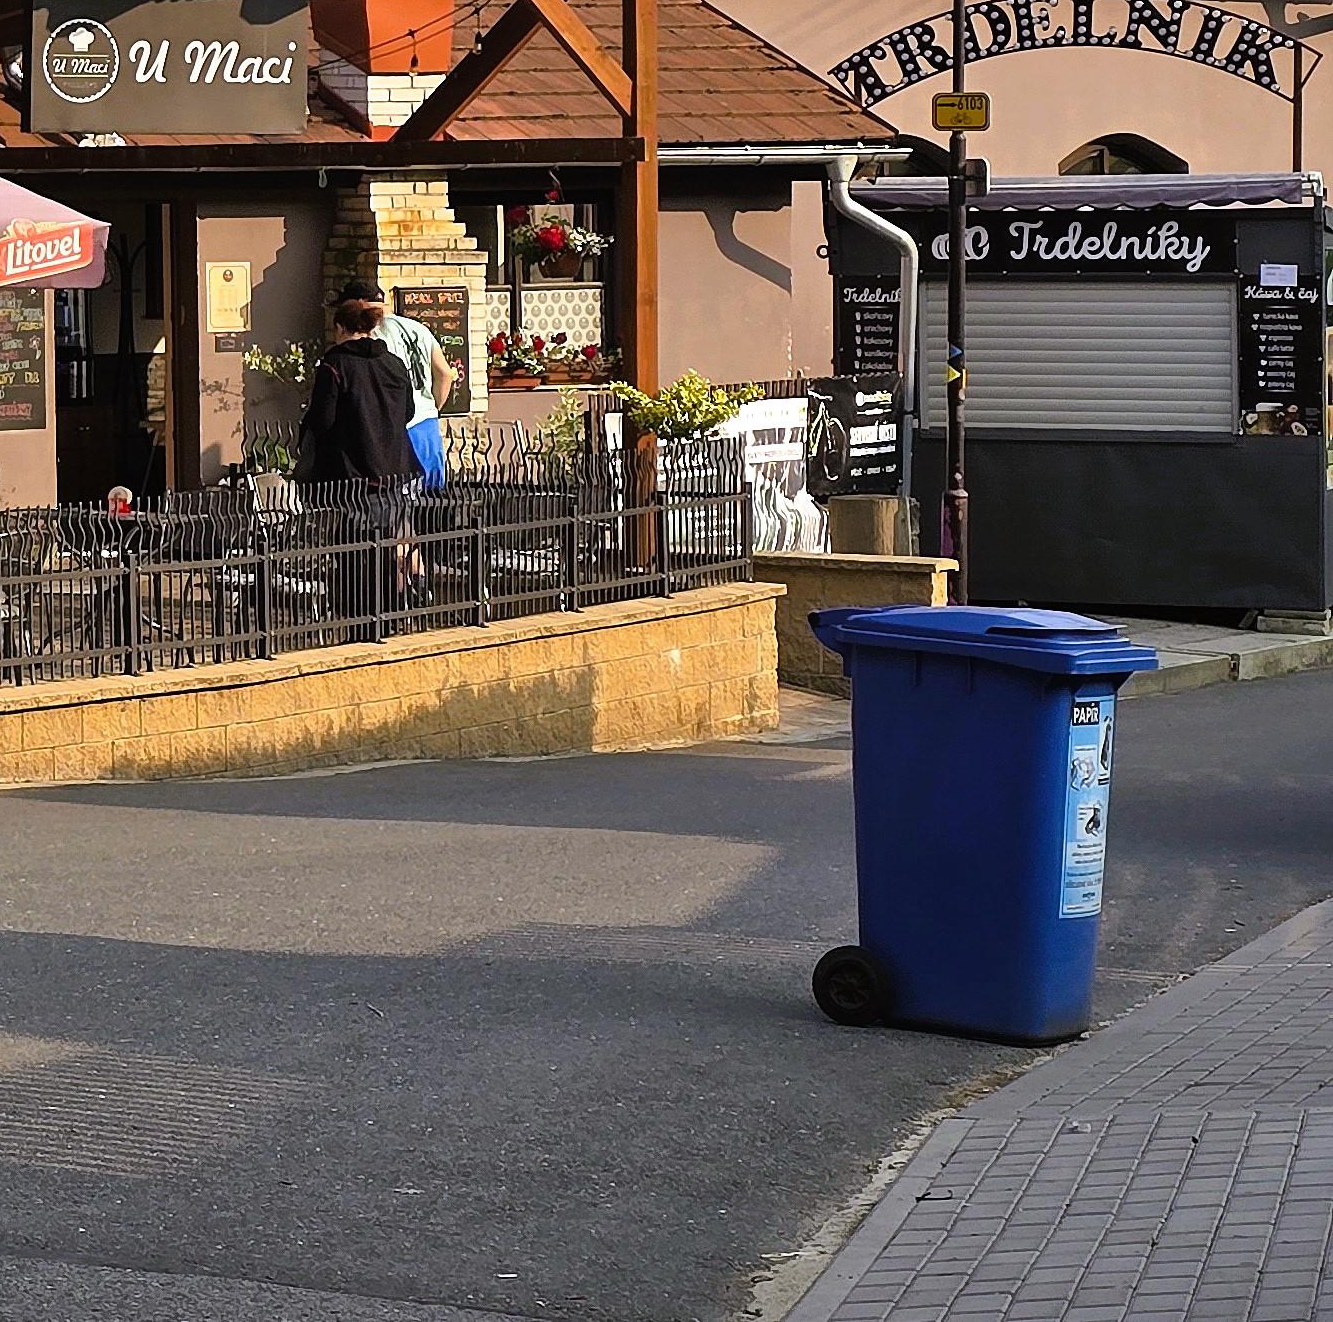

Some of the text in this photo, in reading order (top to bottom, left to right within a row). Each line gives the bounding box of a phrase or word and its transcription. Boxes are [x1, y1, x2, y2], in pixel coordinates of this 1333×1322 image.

[52, 58, 111, 73] U Maci
[129, 39, 297, 84] U Maci
[957, 97, 984, 111] 6103
[5, 227, 82, 277] Litovel
[1009, 220, 1211, 272] Trdelníky
[1073, 702, 1099, 724] PAPÍR
